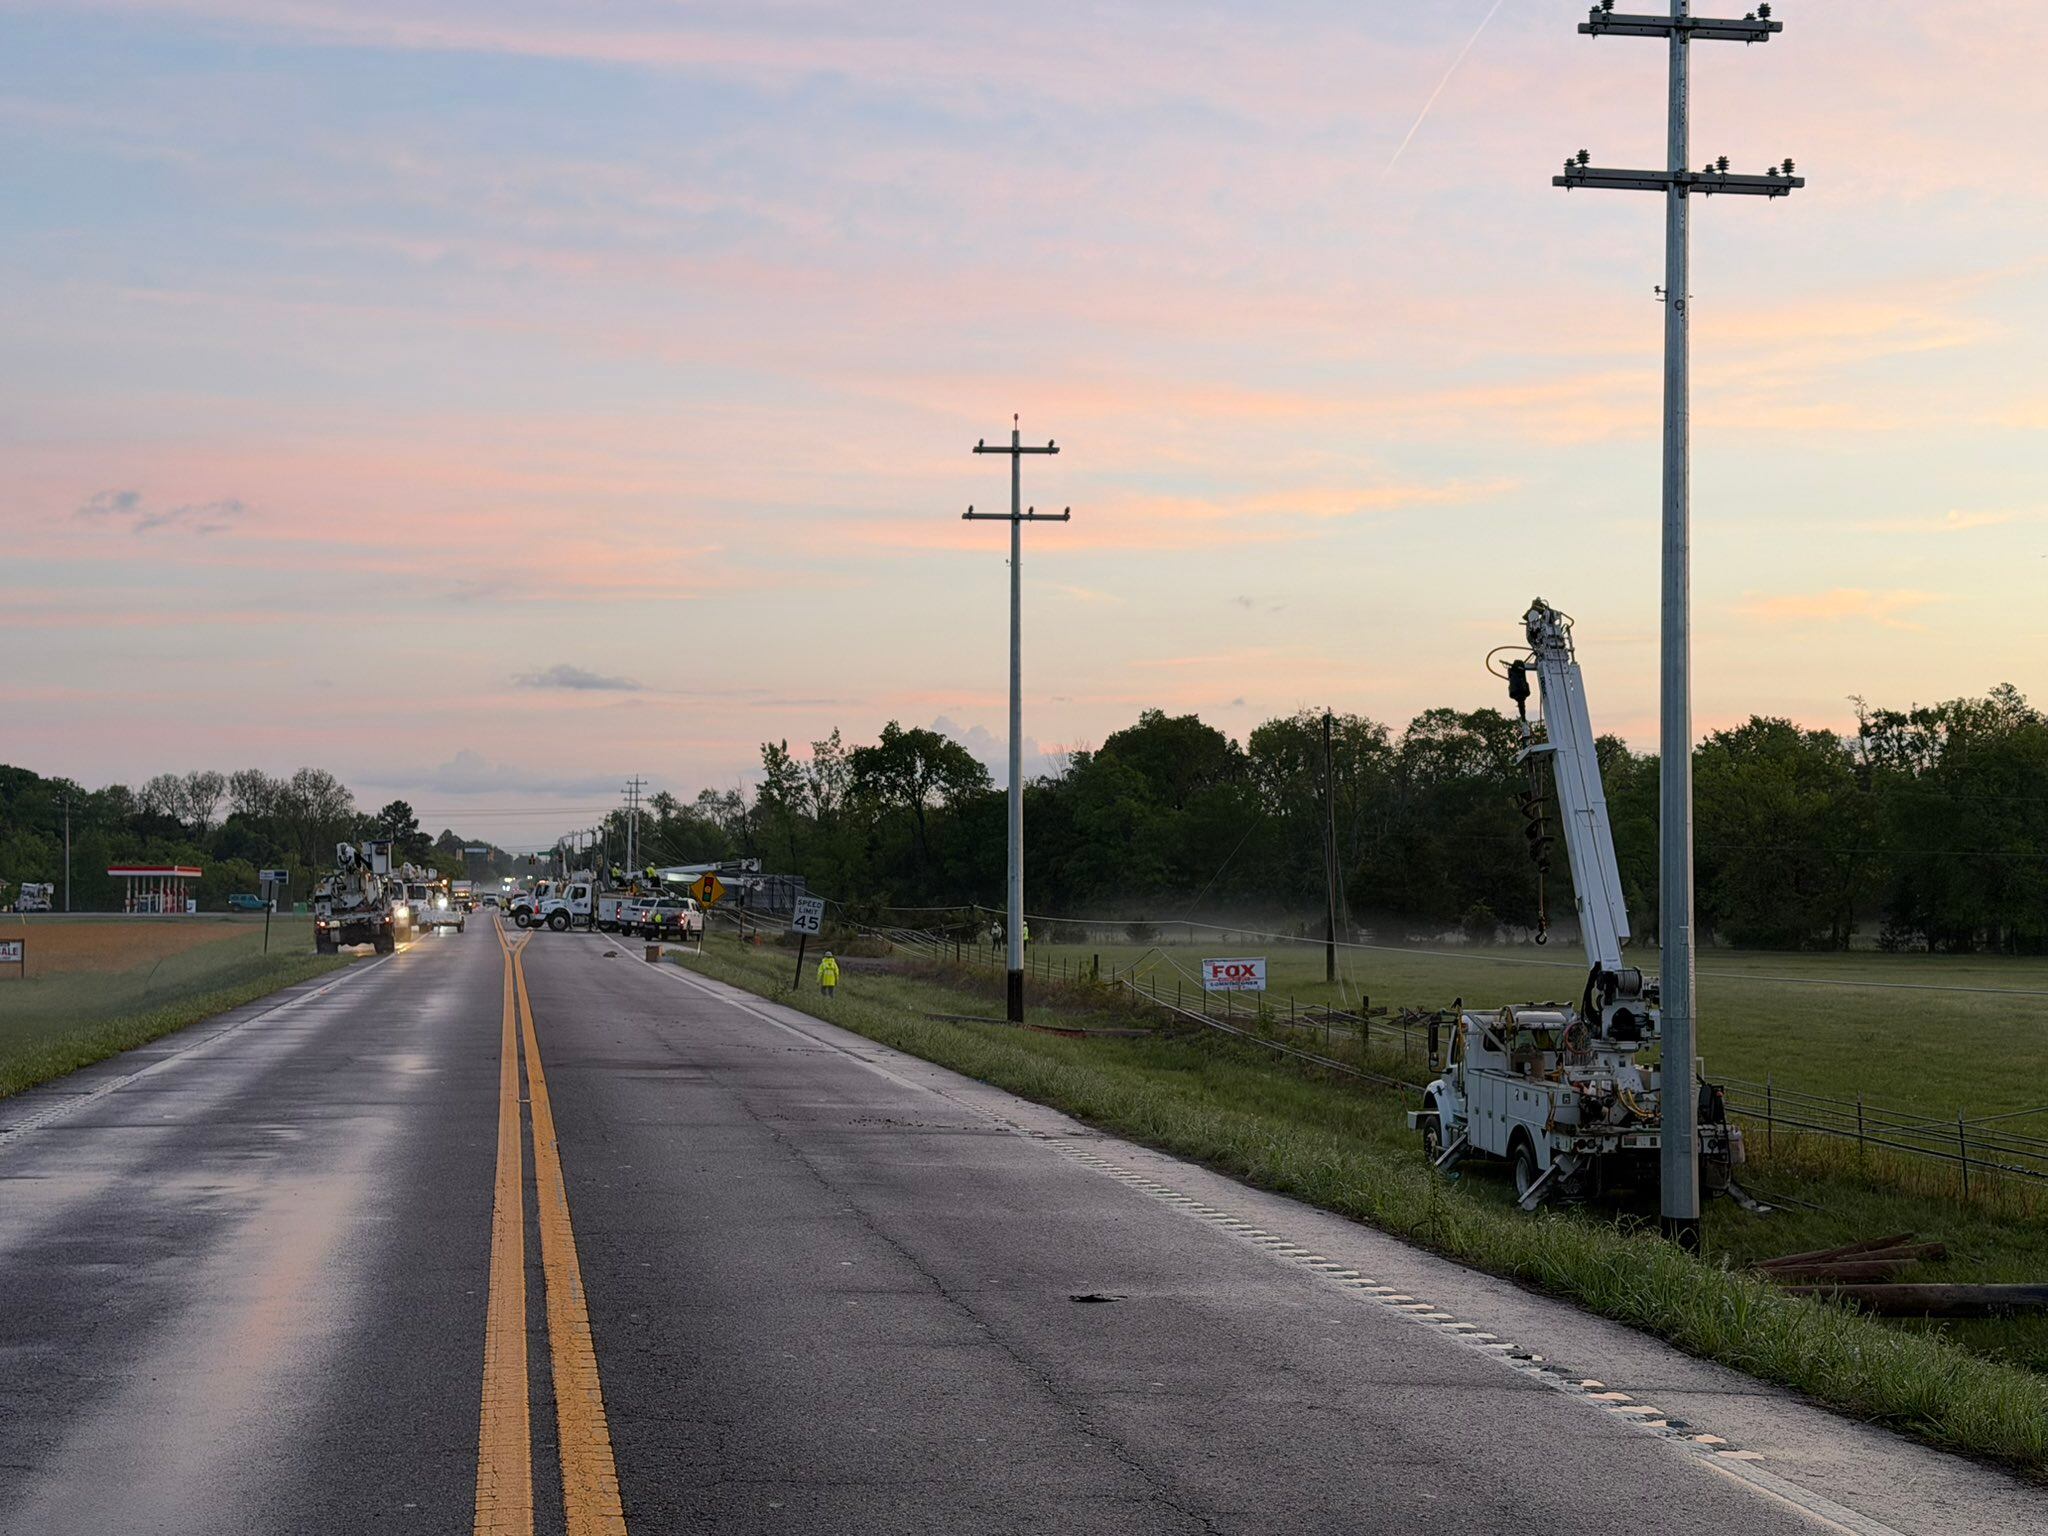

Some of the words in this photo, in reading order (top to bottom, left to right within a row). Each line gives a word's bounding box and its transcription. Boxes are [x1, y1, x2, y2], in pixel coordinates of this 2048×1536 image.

[797, 900, 822, 909] SPEED
[794, 915, 819, 930] 45
[0, 947, 19, 956] ALE
[1212, 963, 1256, 978] FOX
